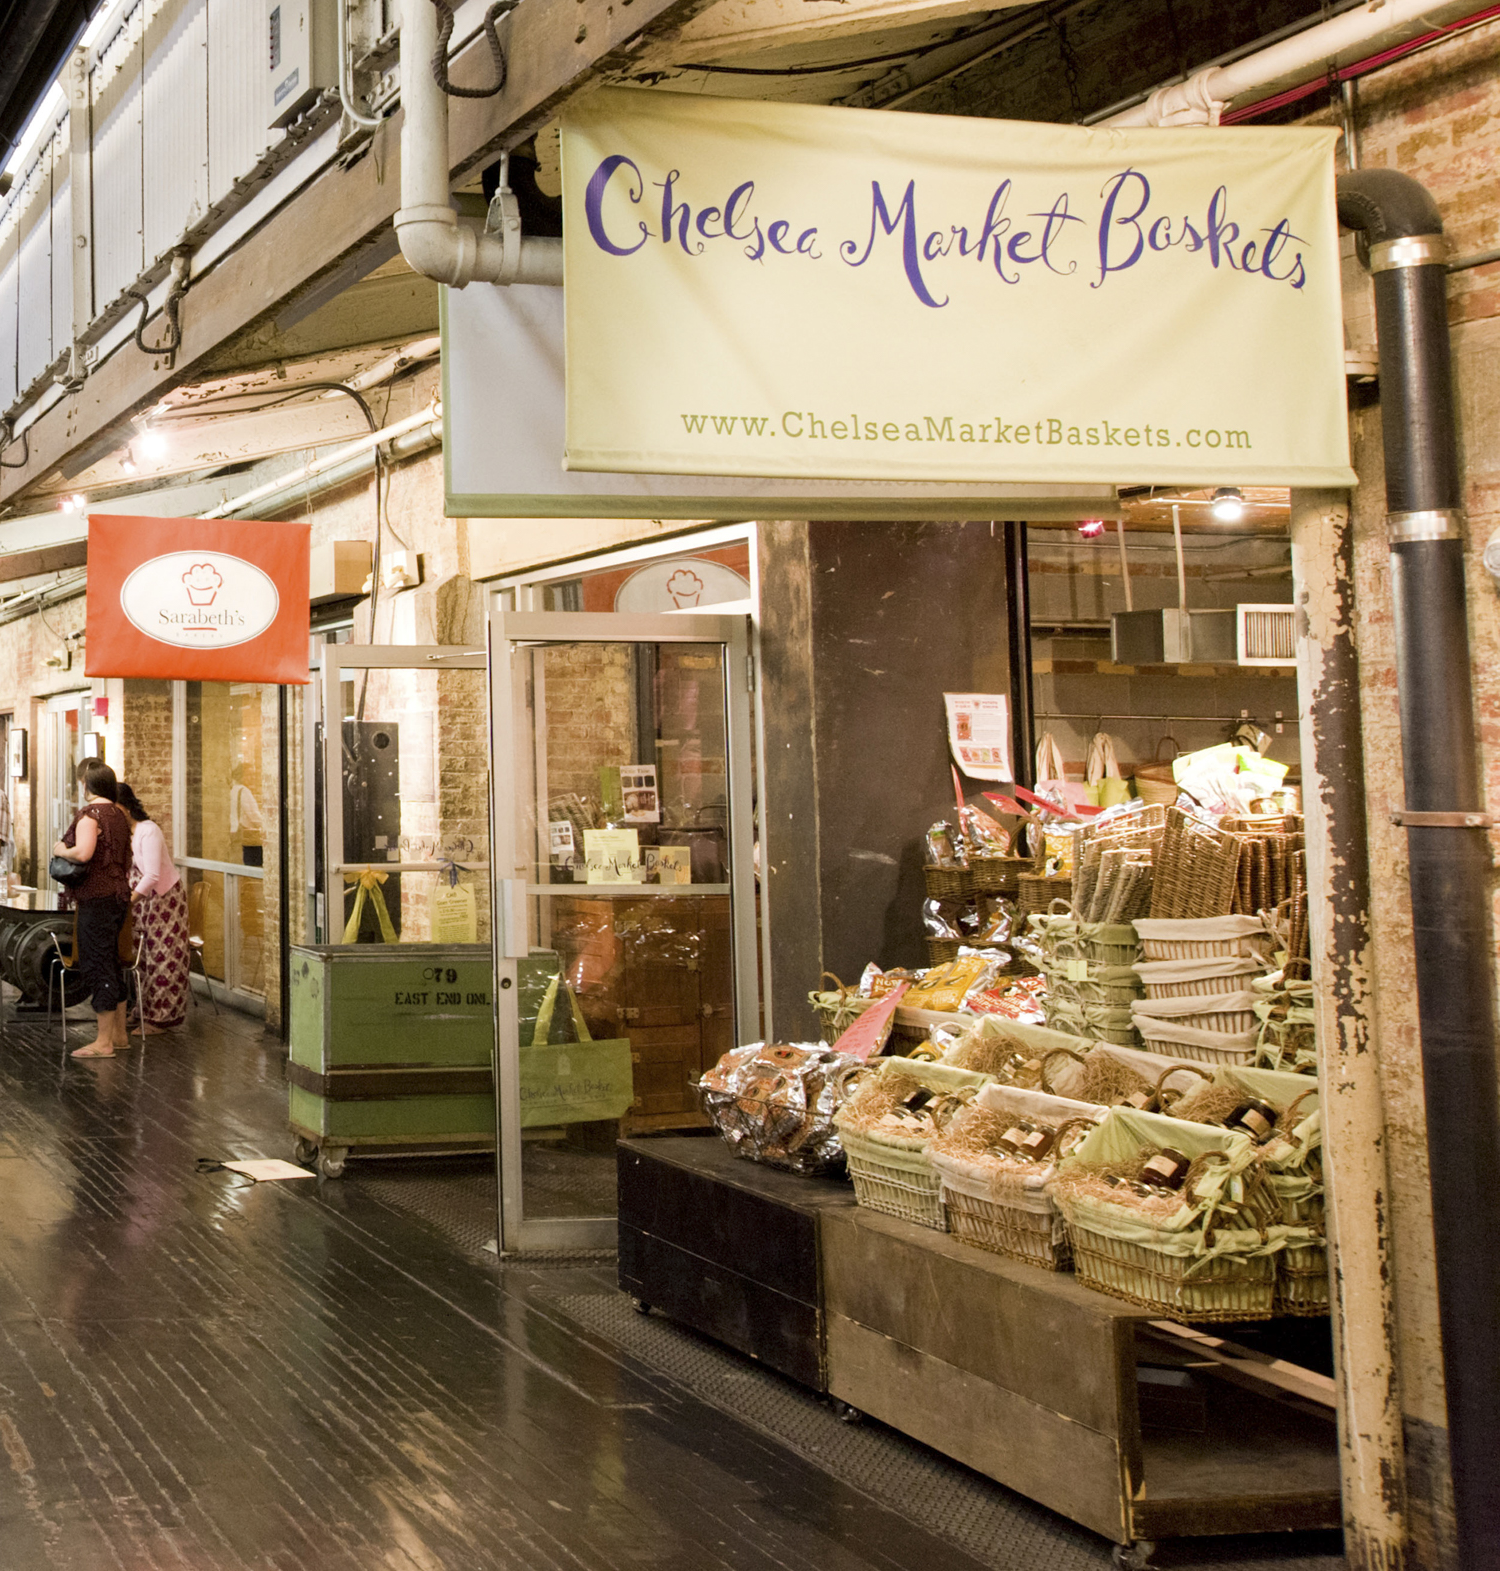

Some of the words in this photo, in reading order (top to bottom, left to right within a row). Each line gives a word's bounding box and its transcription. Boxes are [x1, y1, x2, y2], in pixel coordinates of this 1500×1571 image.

[585, 155, 822, 266] Chelsea
[839, 178, 1087, 308] Market
[1090, 167, 1312, 293] Baskets
[681, 411, 1252, 449] www.ChelseaMarketBaskets.com
[159, 608, 245, 626] Sarabeth's
[395, 992, 429, 1005] EAST
[436, 992, 462, 1006] END
[466, 993, 492, 1006] ONL
